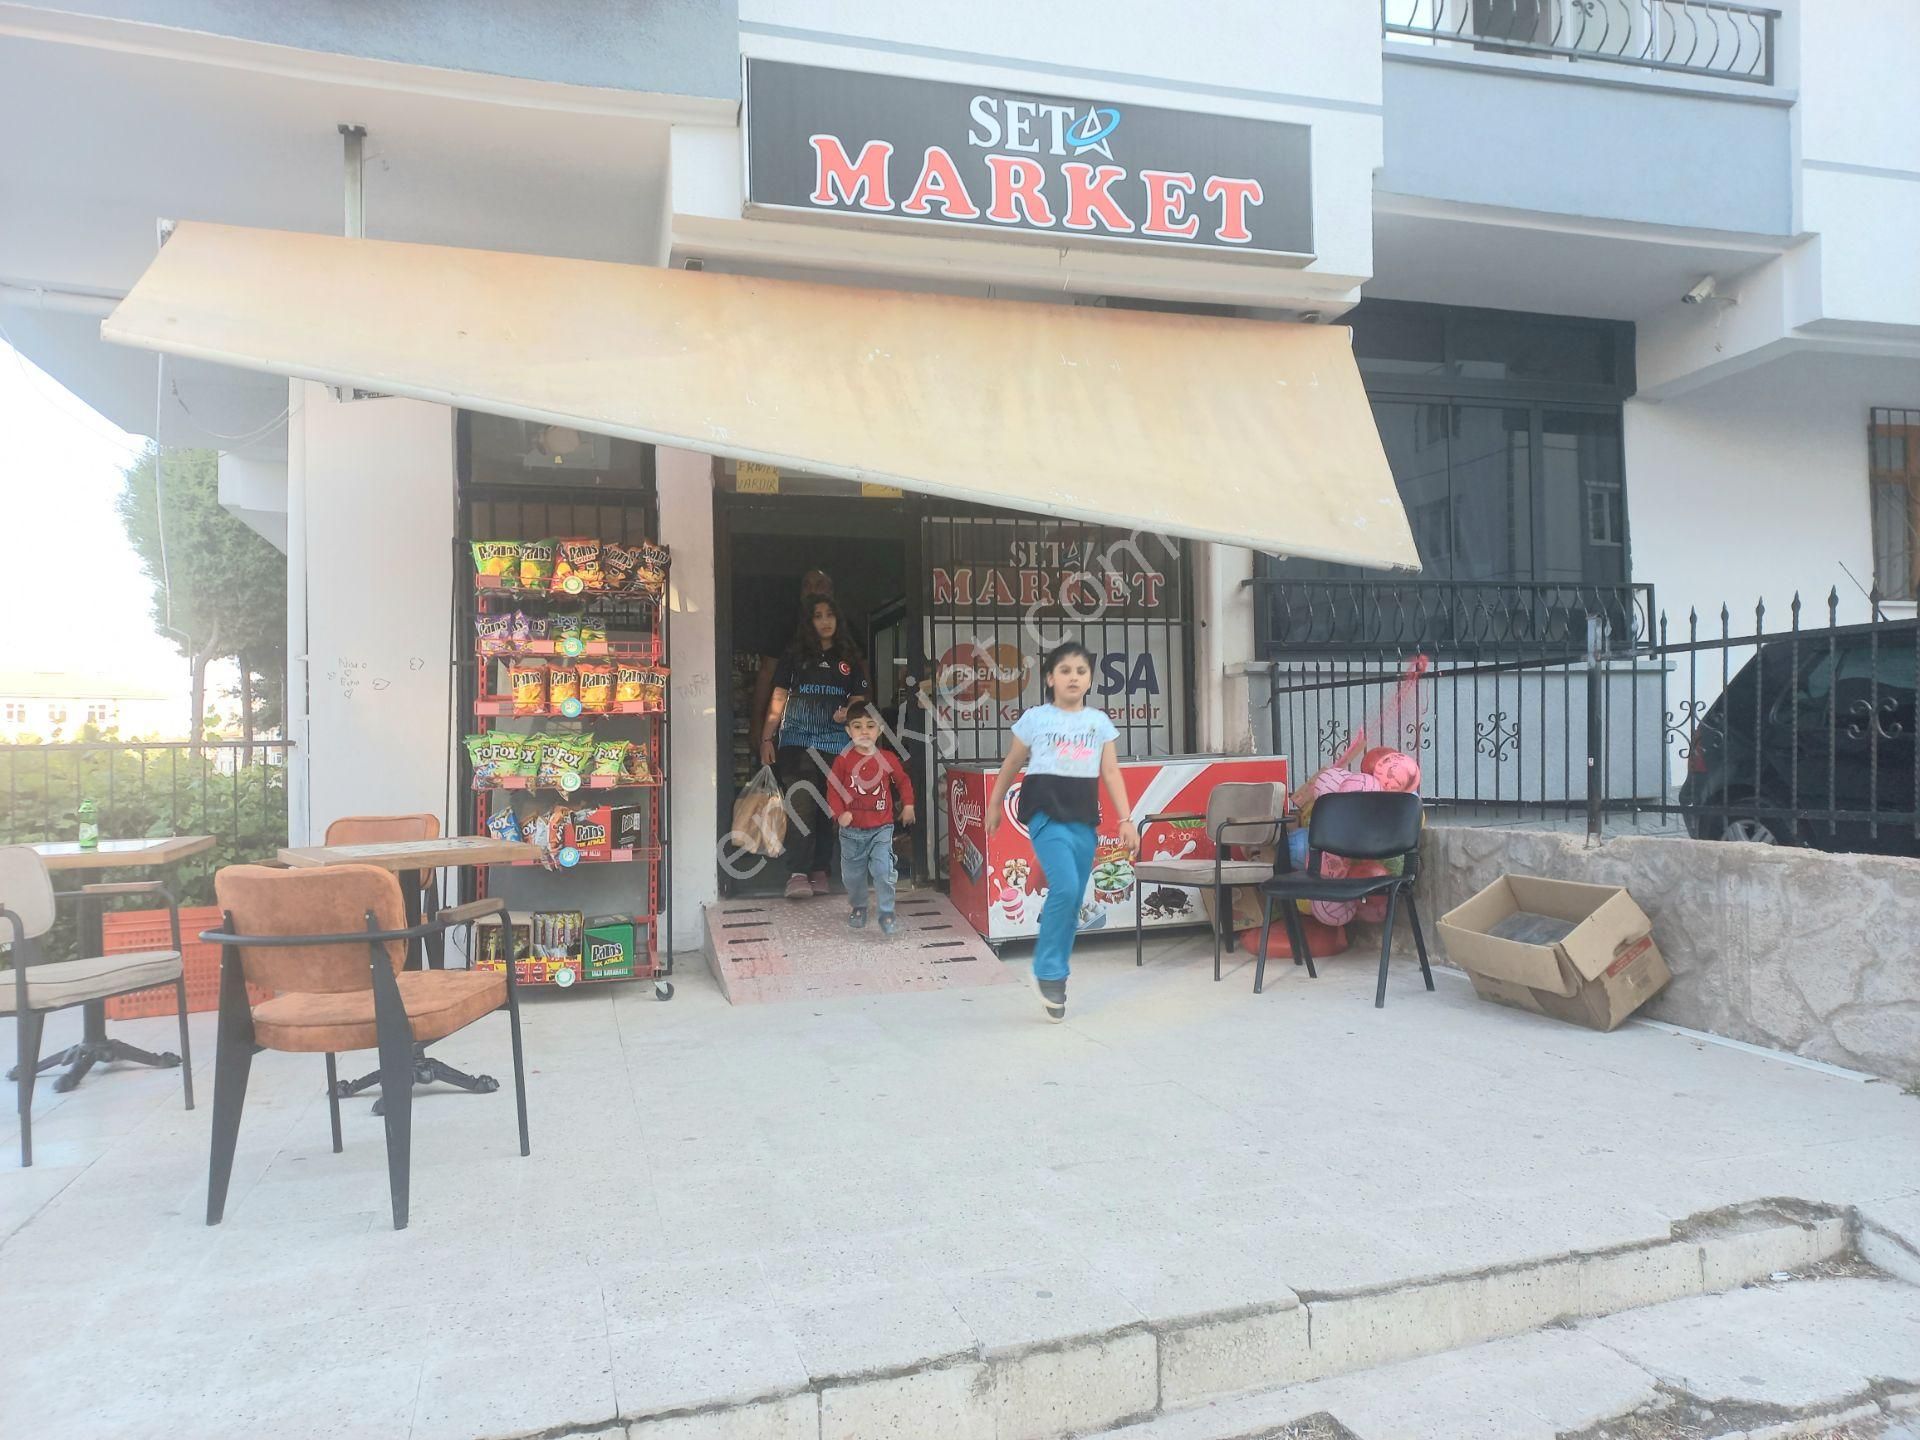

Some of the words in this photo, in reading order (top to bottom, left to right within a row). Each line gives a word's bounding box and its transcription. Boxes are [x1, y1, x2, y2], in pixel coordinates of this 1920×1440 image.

[968, 93, 1121, 160] SETA
[808, 133, 1265, 244] MARKET
[932, 567, 1166, 607] MARKET
[492, 744, 517, 761] FOX
[558, 748, 581, 769] FOX
